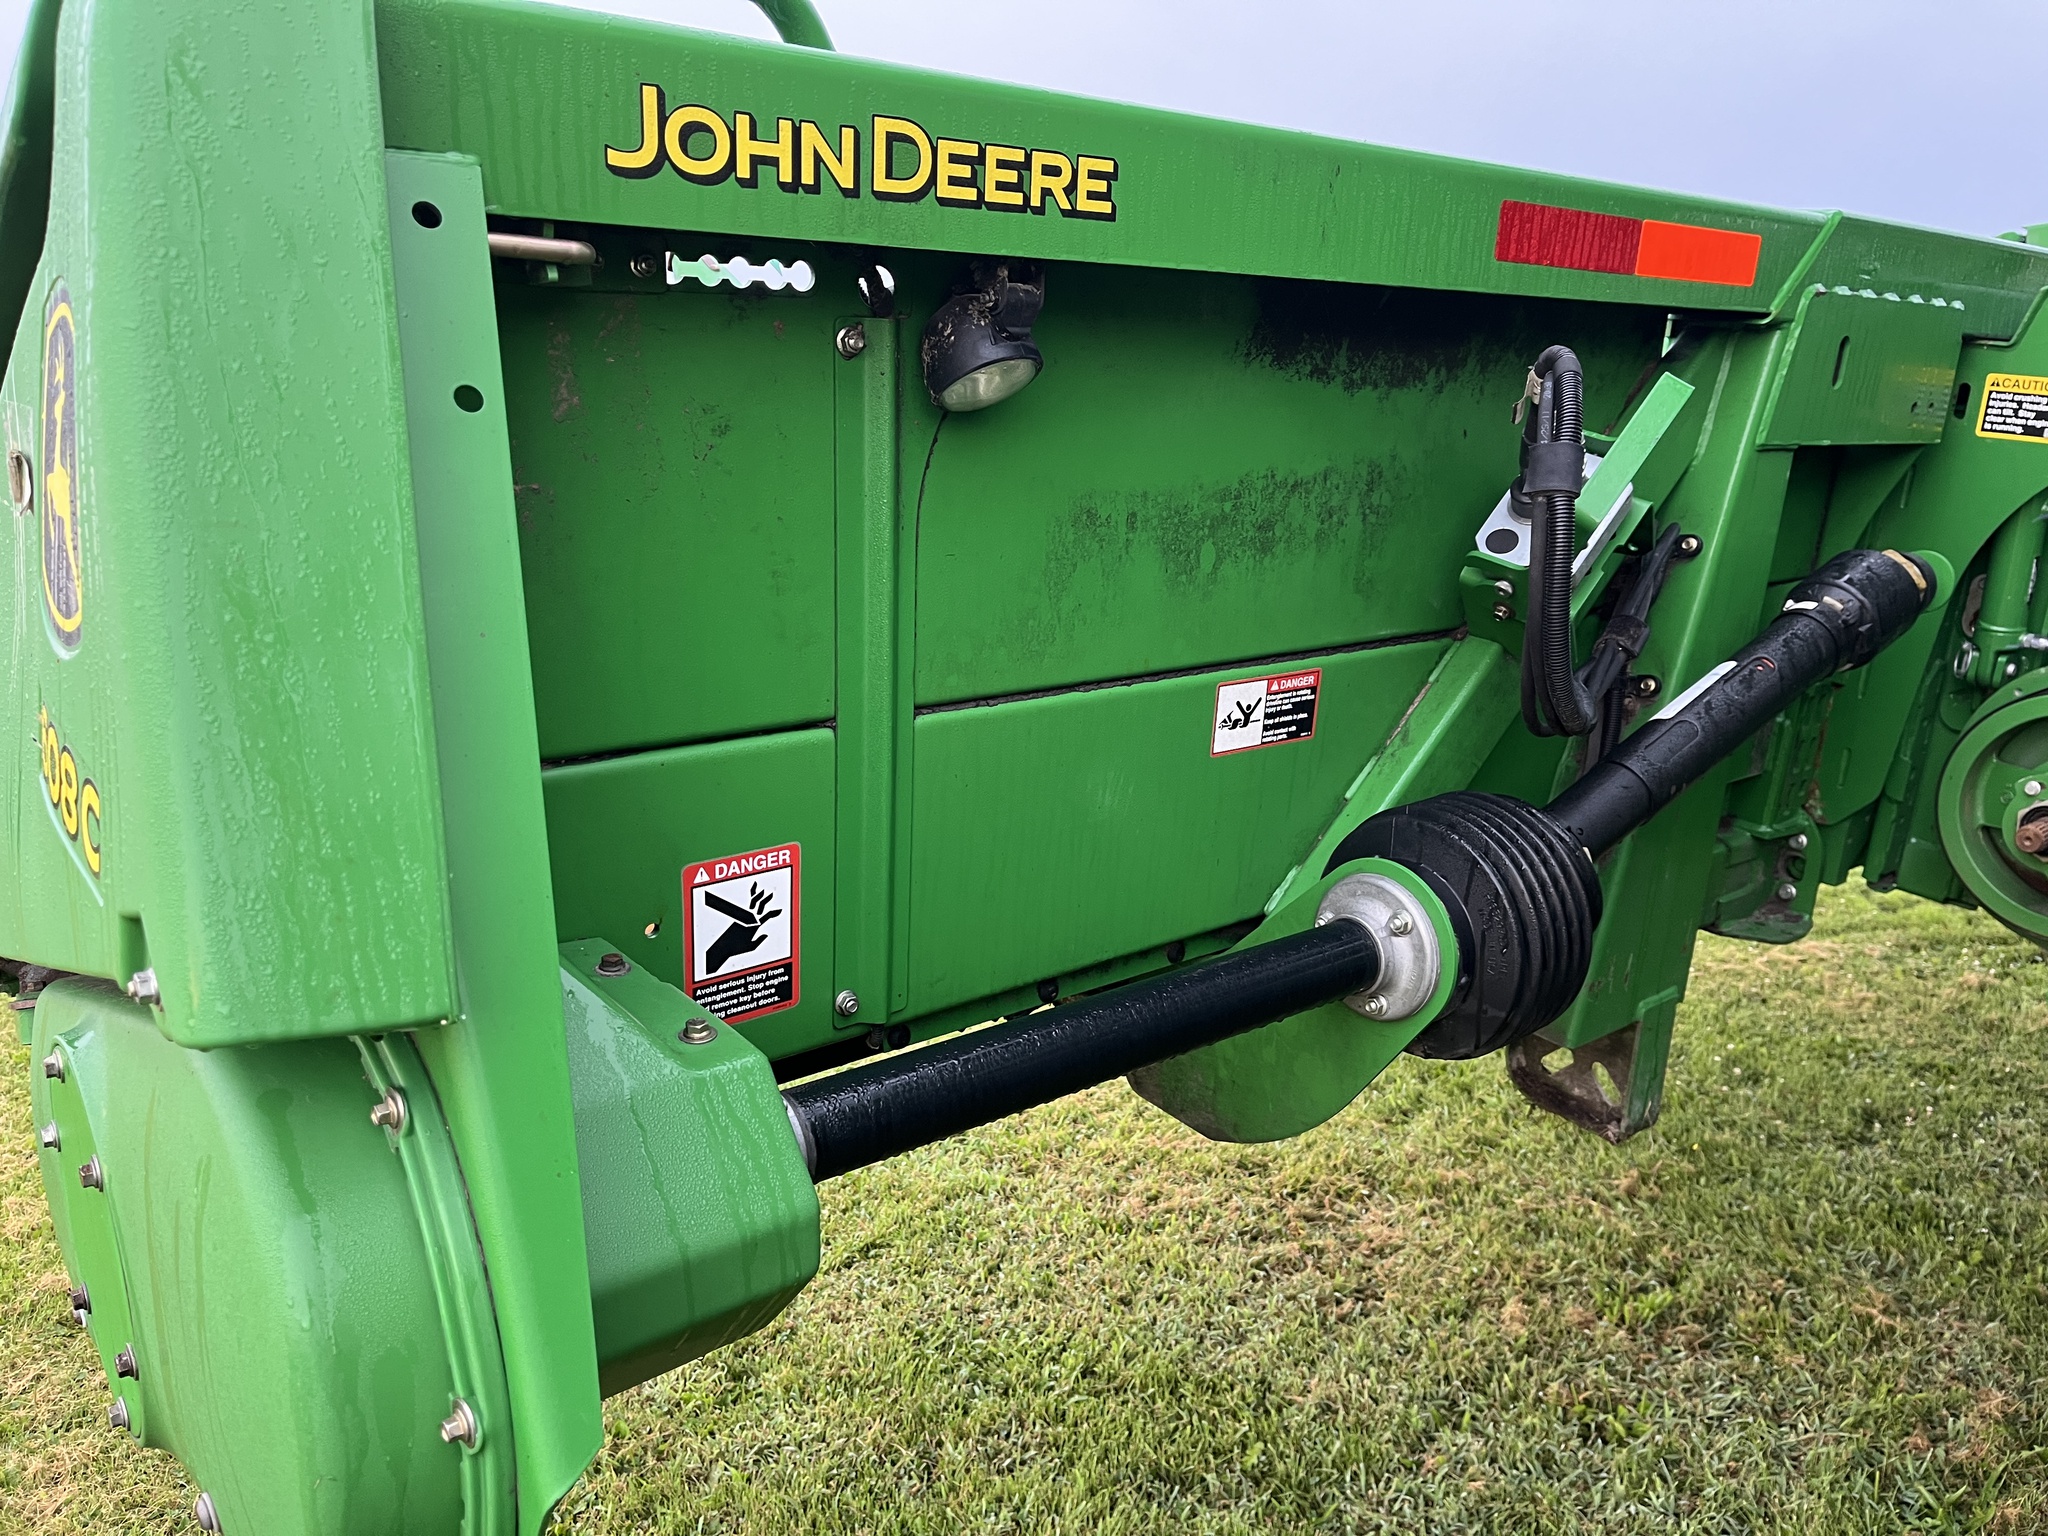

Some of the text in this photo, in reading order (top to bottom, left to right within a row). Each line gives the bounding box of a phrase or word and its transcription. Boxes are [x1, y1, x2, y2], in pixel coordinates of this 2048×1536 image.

[605, 83, 1119, 221] JOHN DEERE
[1990, 391, 2048, 405] Avoid crushing
[2022, 402, 2048, 411] Heade
[1985, 415, 2005, 423] clear
[2005, 416, 2026, 425] when
[1986, 407, 2001, 415] can
[2017, 409, 2036, 419] Stay
[1279, 675, 1314, 690] DANGER
[714, 849, 791, 880] DANGER
[695, 984, 717, 997] Avoid
[718, 978, 745, 990] serious
[767, 967, 784, 976] from
[747, 982, 764, 992] Stop
[765, 974, 789, 986] engine
[711, 998, 738, 1011] remove
[738, 993, 752, 1003] key
[752, 987, 776, 999] before
[726, 1001, 757, 1014] cleanout
[758, 994, 781, 1006] doors.
